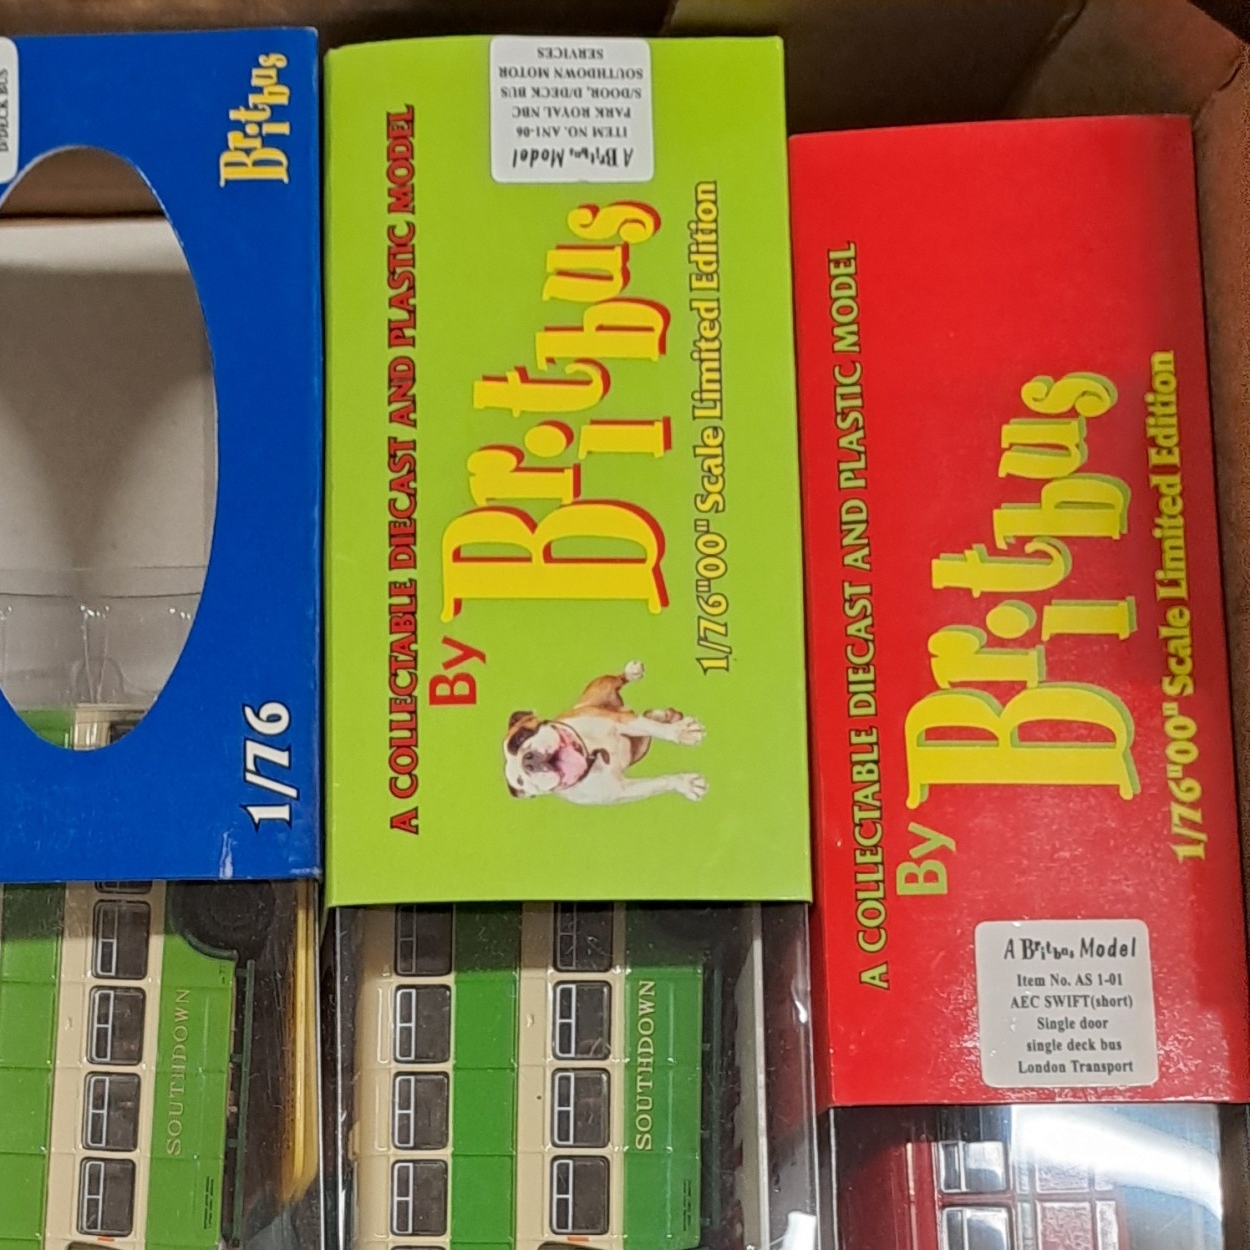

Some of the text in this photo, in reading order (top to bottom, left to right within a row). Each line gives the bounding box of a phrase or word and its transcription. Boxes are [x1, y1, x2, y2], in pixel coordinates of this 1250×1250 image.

[499, 66, 643, 79] SOUTHDOWN MOTOR
[537, 47, 604, 59] SERVICES
[219, 53, 290, 188] Britbus
[512, 105, 630, 118] PARK ROYAL NBC
[688, 180, 720, 293] Edition
[690, 296, 723, 420] Limited
[441, 200, 671, 623] Britbus
[1145, 350, 1181, 469] Edition
[386, 104, 419, 835] A COLLECTABLE DIECAST AND PLASTIC MODEL
[694, 425, 726, 514] Scale
[1151, 473, 1188, 600] Limited
[828, 241, 890, 990] A COLLECTABLE DIECAST AND PLASTIC MODEL
[904, 372, 1141, 810] Britbus
[429, 635, 486, 706] By
[1158, 606, 1194, 696] Scale
[241, 701, 299, 829] 1/76
[896, 822, 956, 895] By
[1004, 937, 1136, 960] A Britbus Model
[1010, 996, 1040, 1009] AEC
[1027, 1038, 1122, 1054] single deck bus
[1037, 1017, 1109, 1033] Single door
[167, 988, 191, 1157] SOUTHDOWN
[635, 980, 656, 1151] SOUTHDOWN
[1018, 1060, 1133, 1075] London Transport
